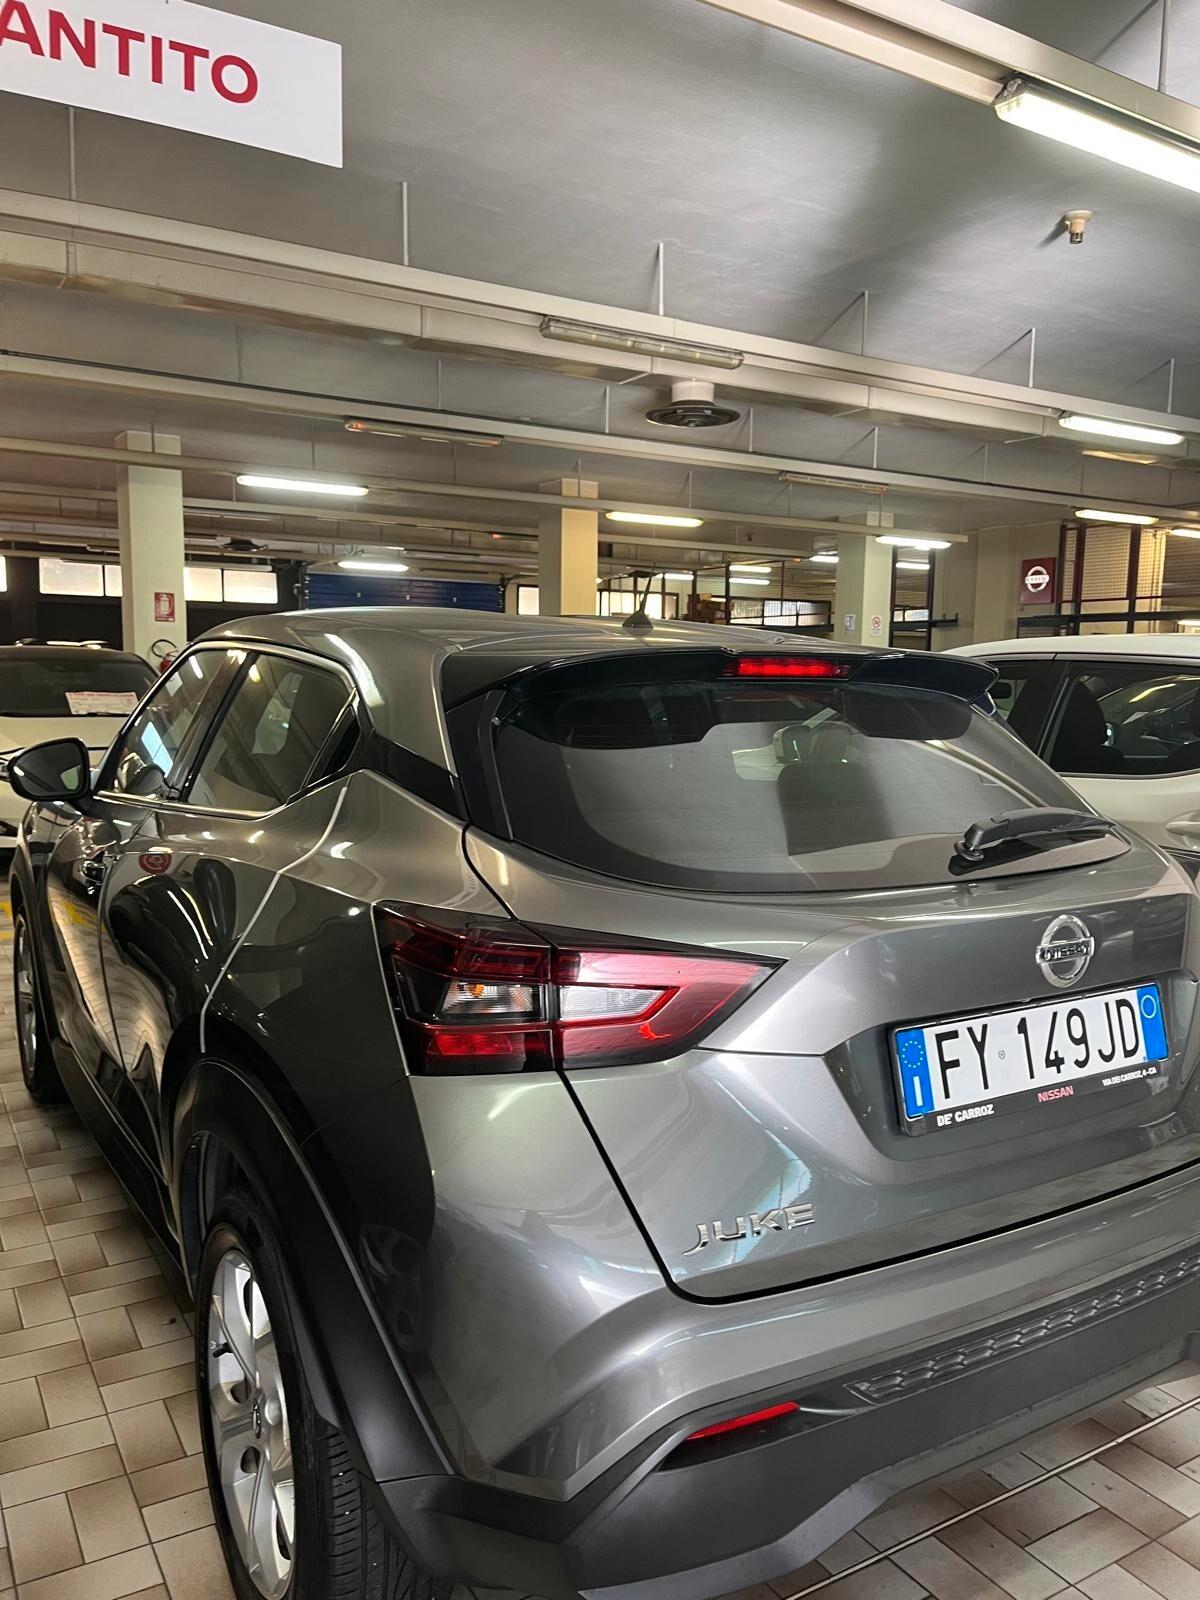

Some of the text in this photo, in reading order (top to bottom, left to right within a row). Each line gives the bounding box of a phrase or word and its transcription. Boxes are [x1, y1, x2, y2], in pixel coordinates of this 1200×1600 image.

[0, 0, 258, 104] ANTITO
[935, 1024, 988, 1100] FY
[954, 1104, 995, 1123] CARROZ
[1037, 1085, 1074, 1103] NISSAN
[682, 1203, 815, 1256] JUKE
